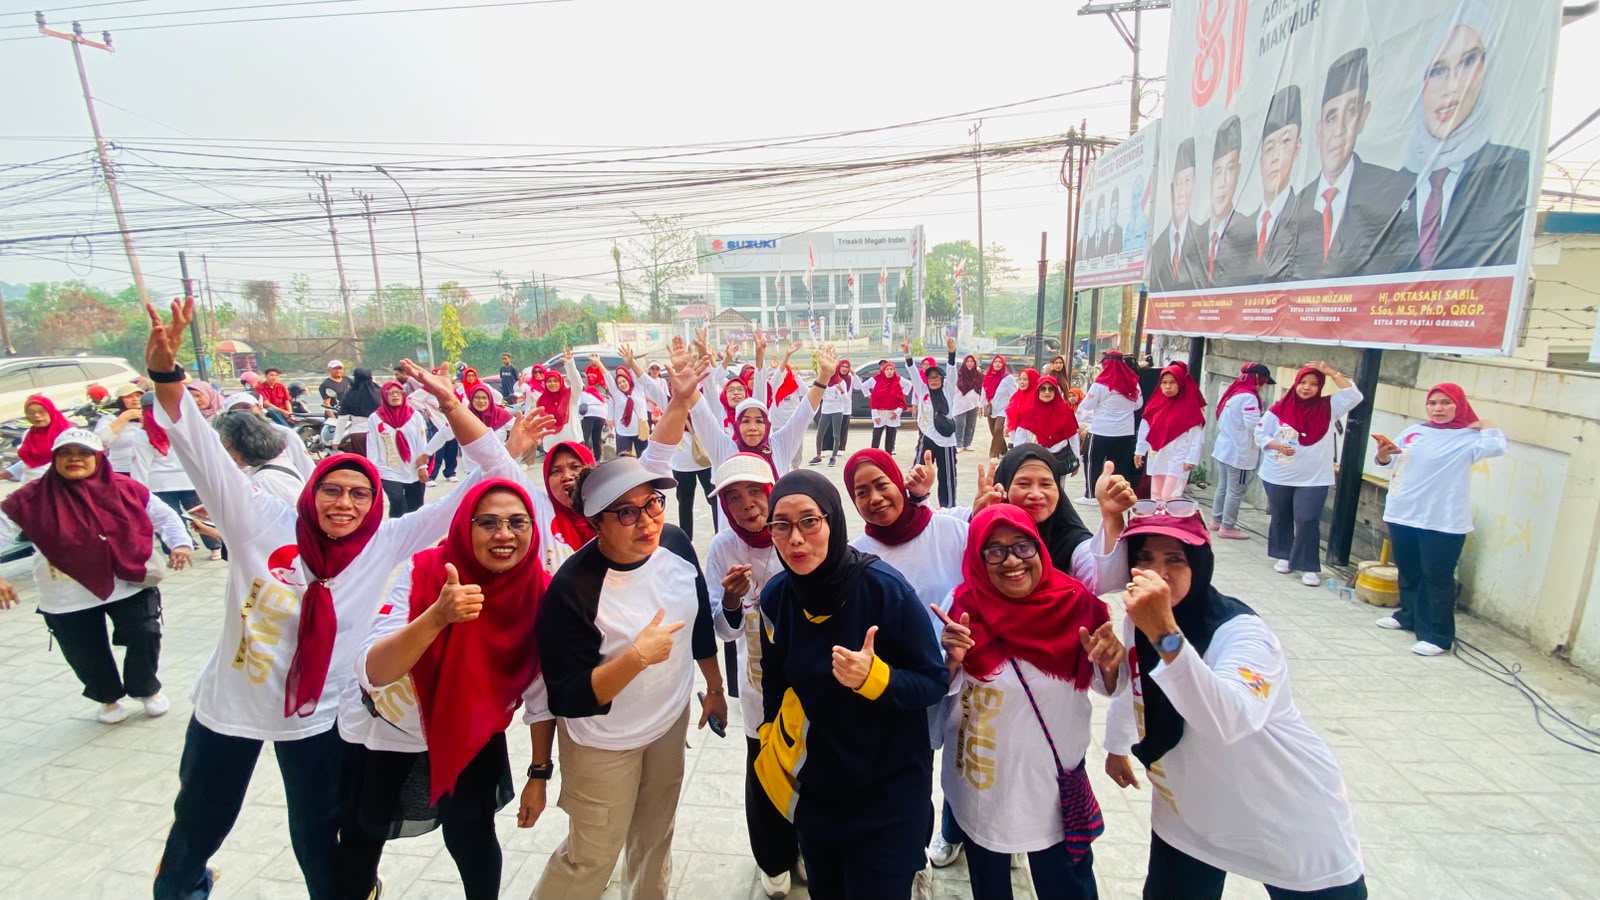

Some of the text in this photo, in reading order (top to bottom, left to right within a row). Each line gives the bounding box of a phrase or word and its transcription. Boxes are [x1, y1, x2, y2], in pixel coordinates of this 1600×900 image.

[1258, 0, 1321, 57] MAKMUR
[727, 240, 776, 249] SUZUKI
[864, 237, 887, 245] Megah
[888, 236, 906, 244] Indah
[1296, 294, 1352, 304] AHMAD MUZANI
[1378, 289, 1479, 304] Hj. OKTASARI SABIL,
[1420, 304, 1446, 316] Ph.D,
[1450, 304, 1485, 316] QRGP.
[1435, 319, 1475, 327] GERINDRA
[964, 686, 1004, 791] EMUD
